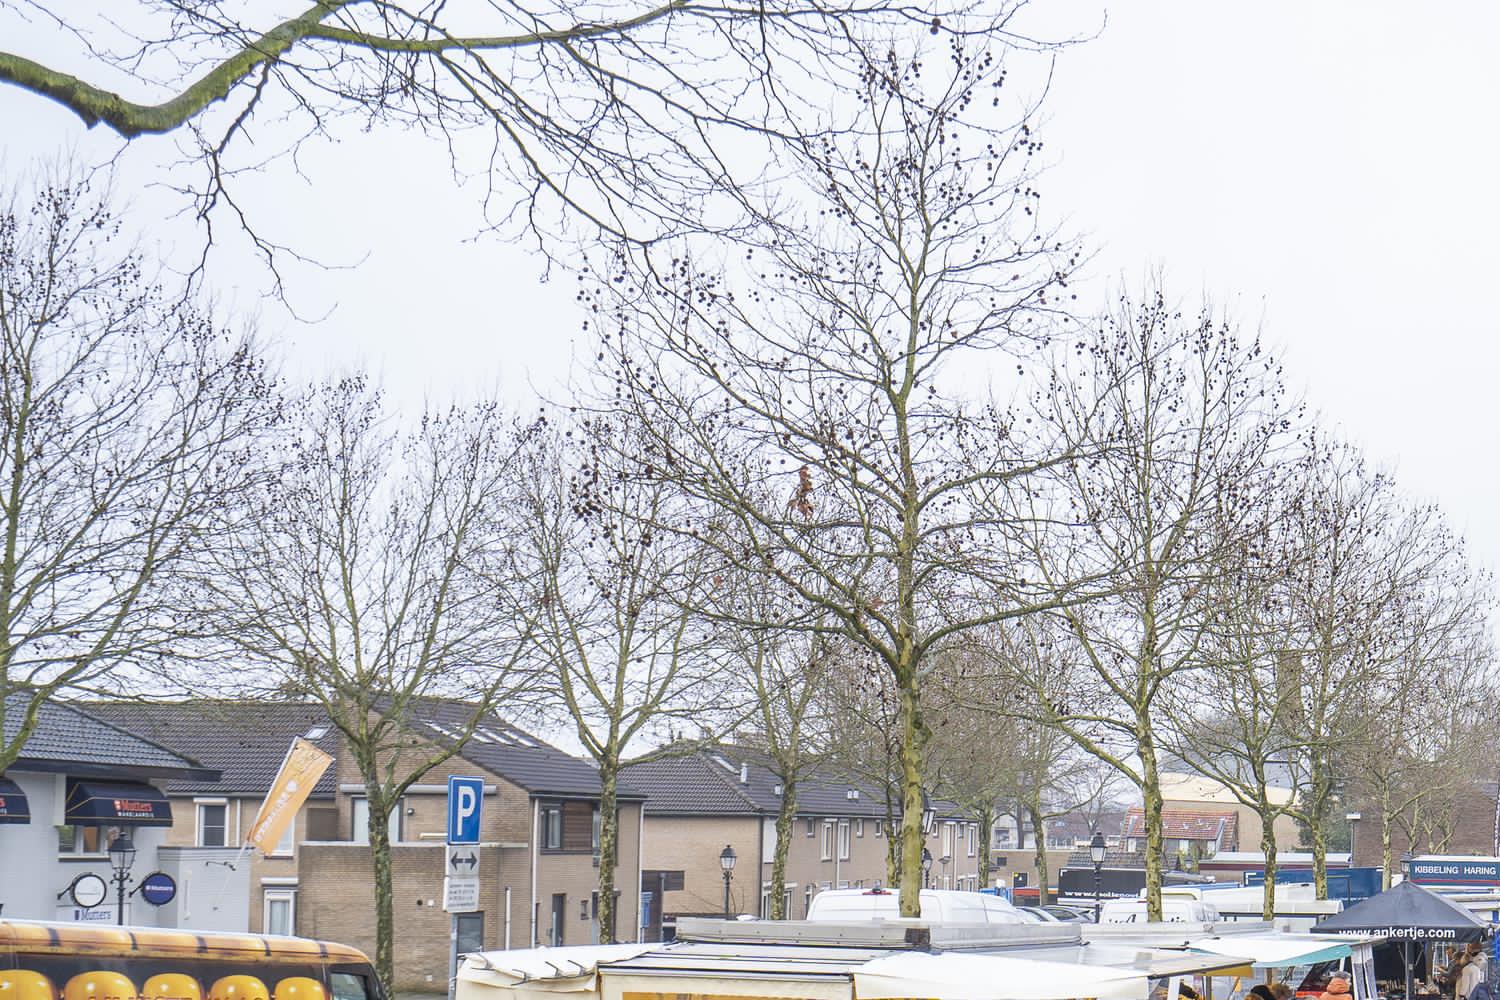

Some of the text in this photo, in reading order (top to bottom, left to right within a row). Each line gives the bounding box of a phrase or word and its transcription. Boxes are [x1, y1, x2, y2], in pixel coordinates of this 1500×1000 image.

[457, 785, 477, 837] P
[1414, 865, 1498, 876] KIBBELING HARING
[1338, 926, 1456, 940] www.ankertje.com
